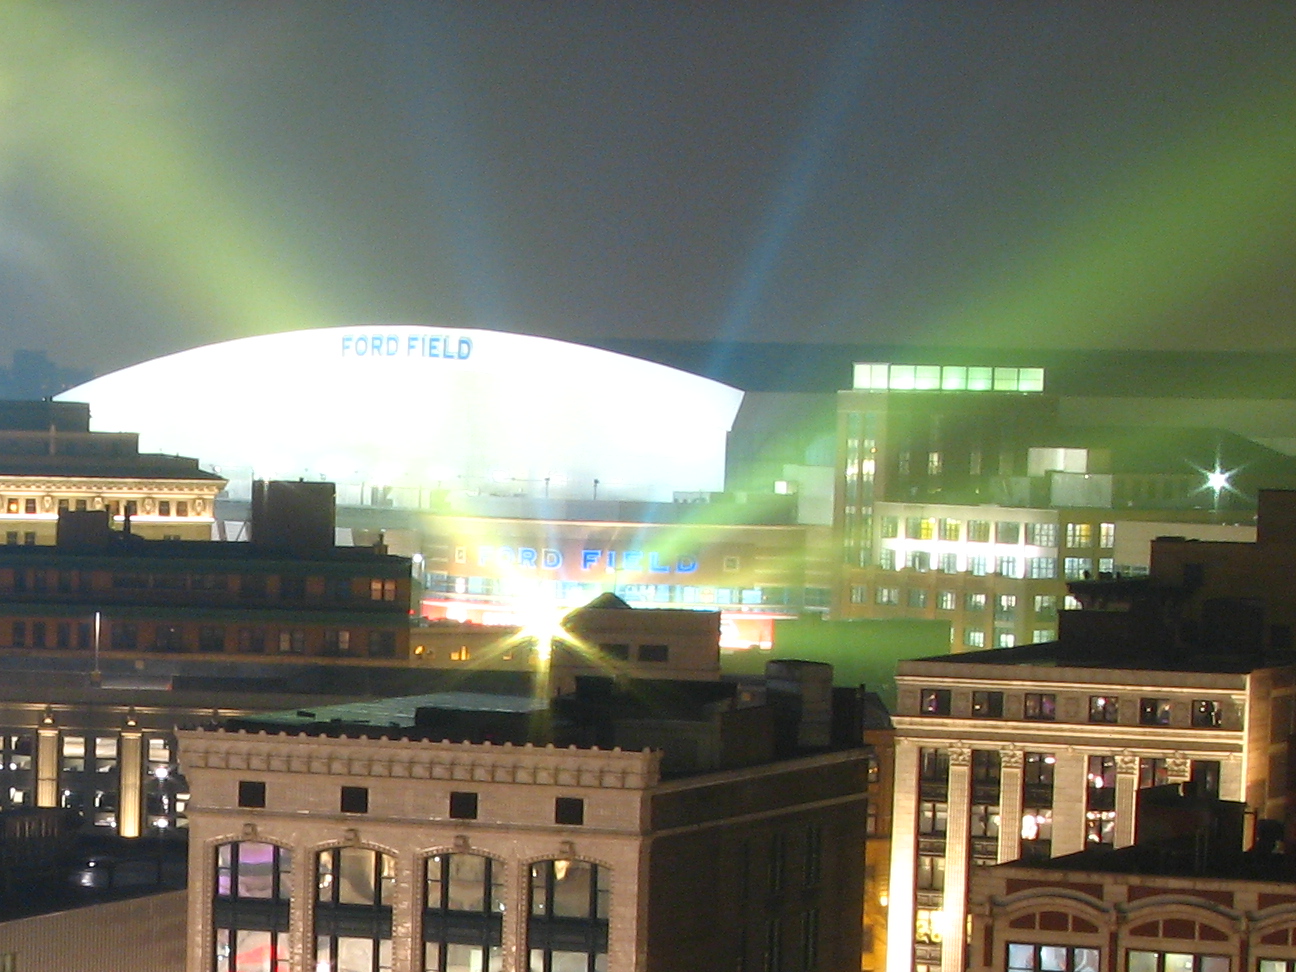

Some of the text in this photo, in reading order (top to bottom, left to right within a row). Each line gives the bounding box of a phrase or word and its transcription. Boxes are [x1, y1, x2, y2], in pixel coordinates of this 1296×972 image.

[341, 334, 473, 360] FORD FIELD
[477, 546, 700, 574] FORD FIELD
